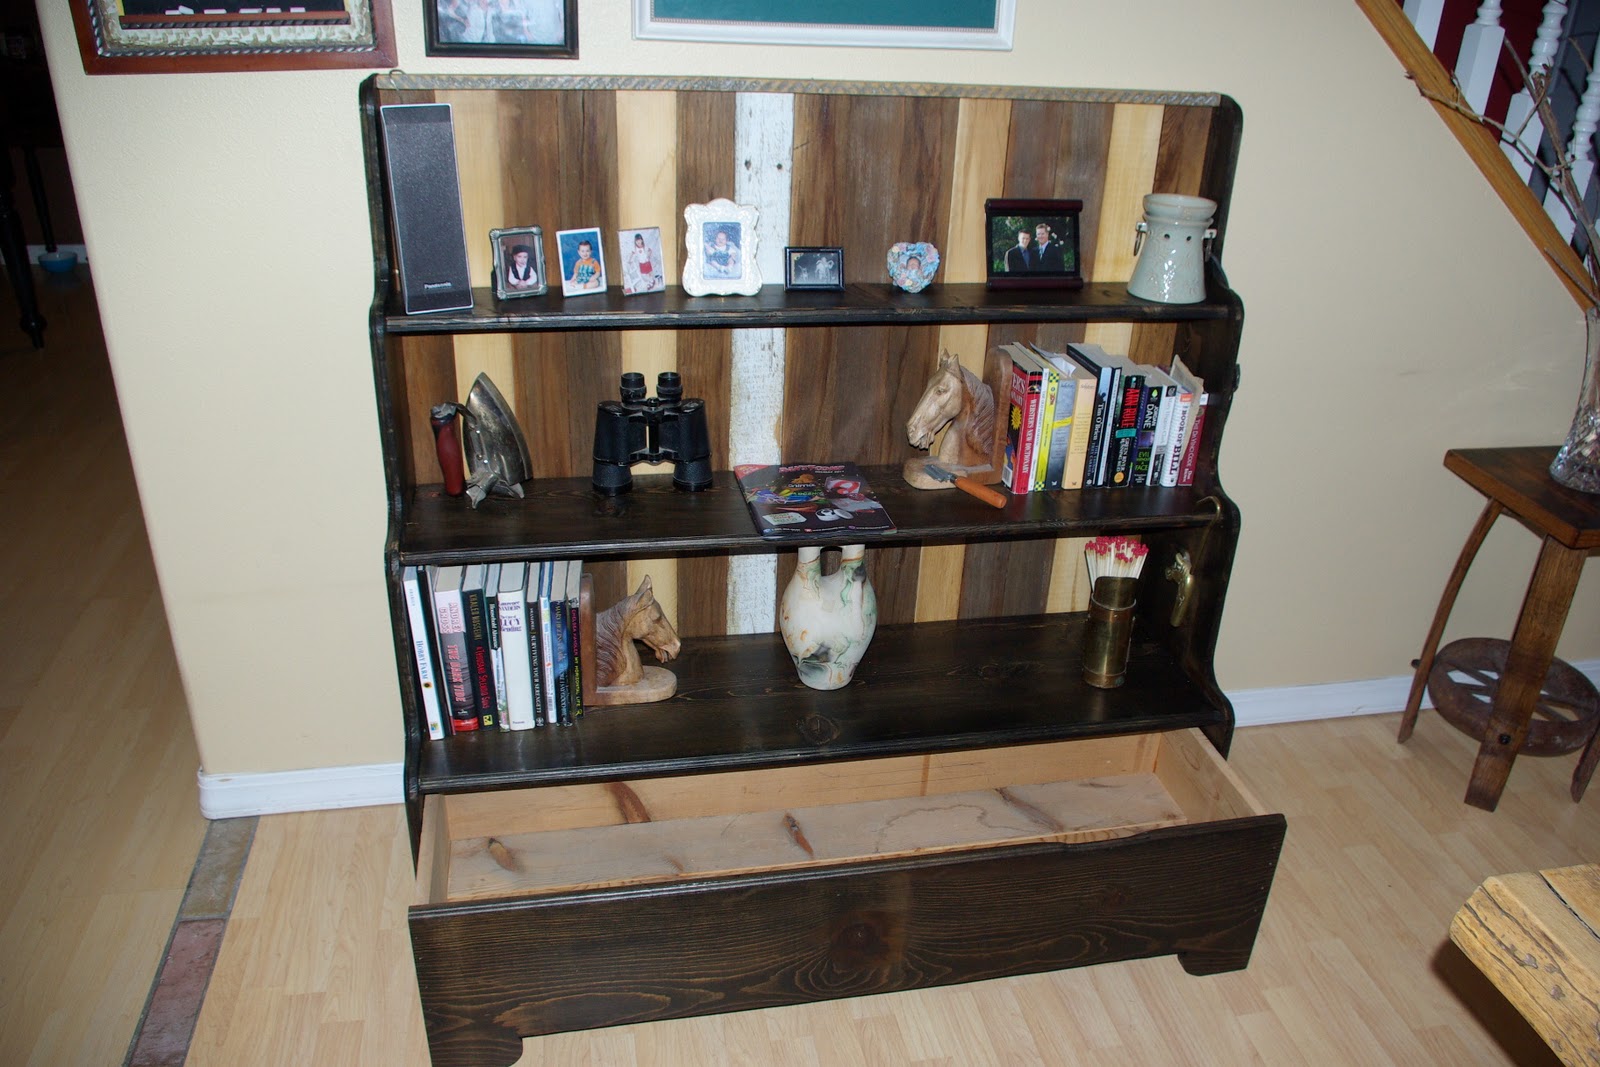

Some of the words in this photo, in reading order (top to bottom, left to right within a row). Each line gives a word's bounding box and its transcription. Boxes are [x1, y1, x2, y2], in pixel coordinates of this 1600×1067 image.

[1124, 388, 1140, 406] ANN
[1027, 399, 1037, 428] WEBSTER'S
[1120, 407, 1137, 428] RULE
[1143, 404, 1155, 429] DANE
[1179, 410, 1187, 431] BOOK
[1026, 429, 1034, 441] NEW
[1093, 417, 1102, 441] O'Brien
[1176, 433, 1184, 444] OF
[1122, 438, 1130, 455] GREEN
[1022, 442, 1032, 474] DICTIONARY
[1169, 445, 1182, 475] BILL
[469, 594, 480, 615] KHALED
[489, 603, 497, 629] Household
[472, 615, 482, 640] HOSSEINI
[416, 640, 425, 661] HOBBY
[447, 644, 460, 660] THE
[531, 635, 539, 667] SURVIVING
[574, 656, 579, 664] MY
[420, 662, 429, 680] FARM
[450, 661, 463, 683] DARK
[454, 684, 466, 702] TIDE
